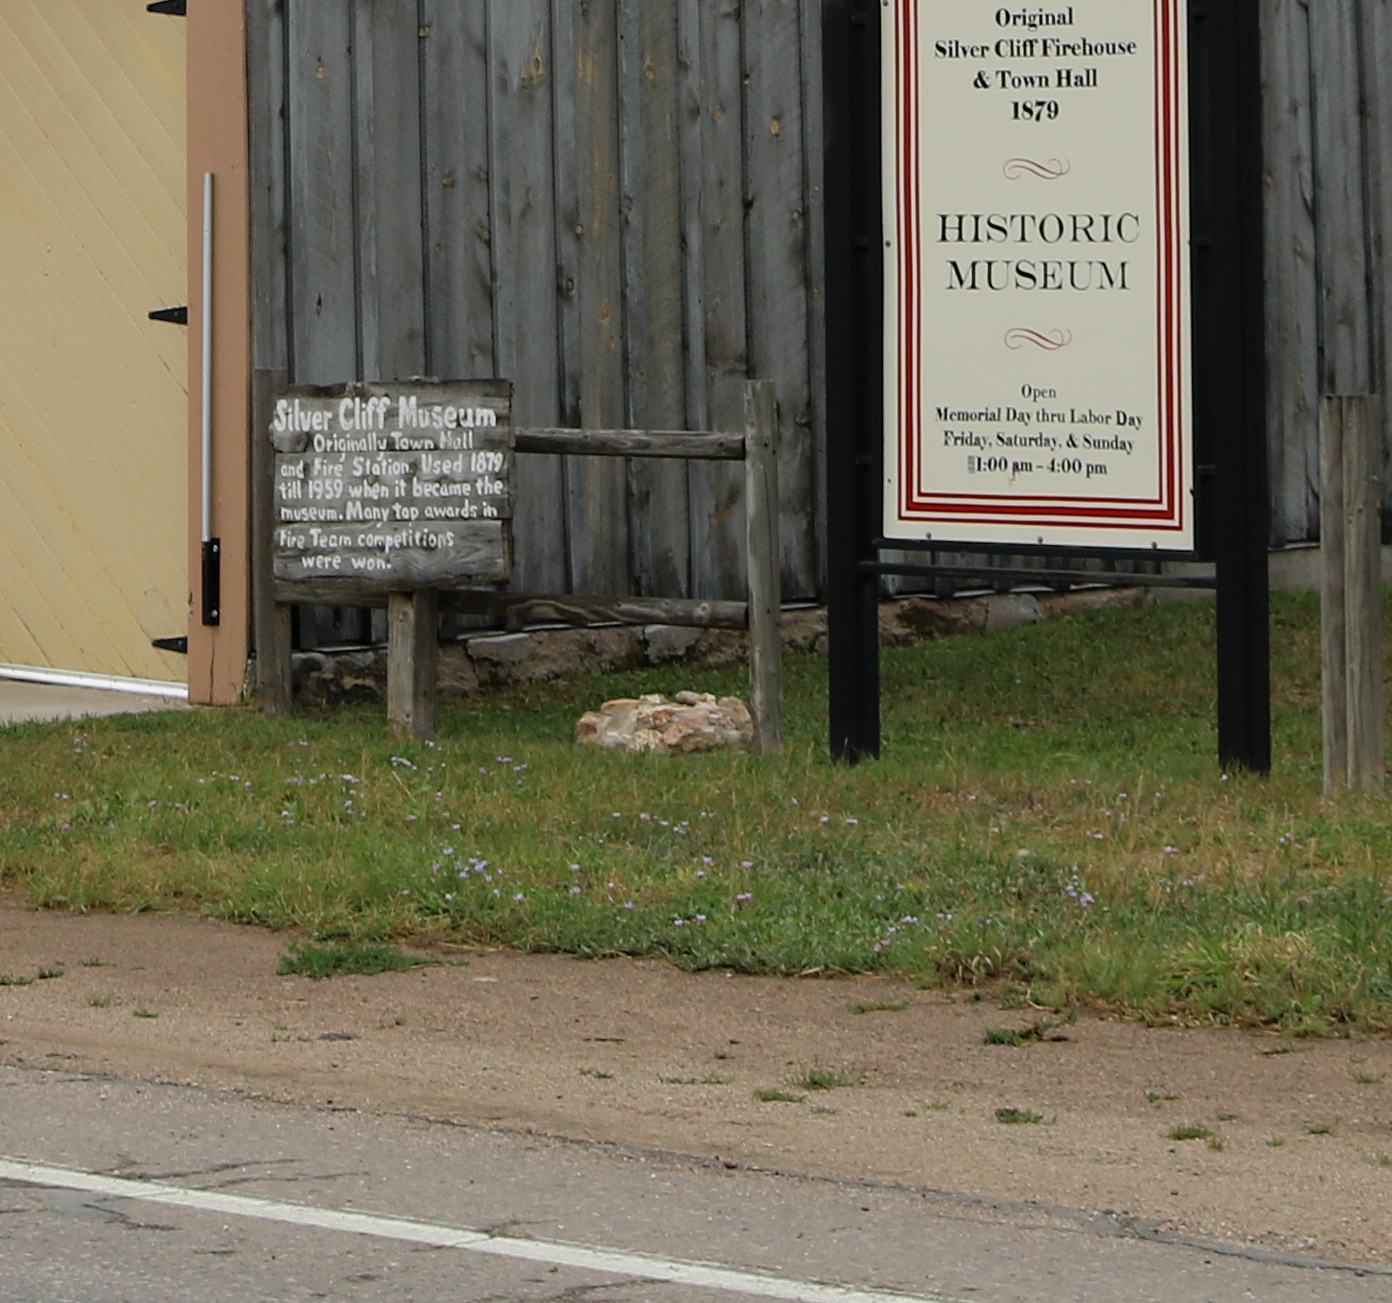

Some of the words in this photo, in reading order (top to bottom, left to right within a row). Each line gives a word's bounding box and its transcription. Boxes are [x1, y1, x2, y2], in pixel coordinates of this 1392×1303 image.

[995, 6, 1075, 32] Original
[934, 39, 990, 59] Silver
[994, 38, 1039, 58] Cliff
[1041, 37, 1138, 57] Firehouse
[973, 70, 990, 89] &
[995, 69, 1050, 89] Town
[1055, 68, 1098, 88] Hall
[1011, 100, 1060, 122] 1879
[935, 212, 1141, 244] HISTORIC
[945, 259, 1131, 291] MUSEUM
[1020, 384, 1057, 402] Open
[273, 398, 332, 432] Silver
[338, 396, 391, 431] Cliff
[398, 395, 497, 429] Museum
[935, 406, 1002, 422] Memorial
[1006, 407, 1033, 426] Day
[1036, 408, 1065, 423] thru
[1070, 409, 1112, 425] Labor
[1115, 410, 1143, 430] Day
[313, 432, 387, 462] Originally
[391, 431, 435, 451] Town
[439, 431, 474, 450] Hall
[943, 430, 993, 451] Friday,
[996, 431, 1063, 452] Saturday,
[1066, 433, 1078, 449] &
[1082, 433, 1134, 455] Sunday
[281, 460, 304, 478] and
[313, 457, 343, 478] Fire
[421, 453, 463, 474] Used
[470, 452, 505, 473] 1879
[1047, 457, 1082, 473] 4:00
[1085, 461, 1108, 478] pm
[278, 479, 302, 500] till
[308, 479, 344, 500] 1959
[349, 477, 390, 499] when
[394, 478, 407, 498] it
[412, 475, 471, 497] became
[475, 475, 505, 496] the
[281, 506, 344, 521] museum.
[346, 501, 391, 528] Many
[392, 502, 420, 526] top
[424, 499, 479, 519] awards
[483, 501, 498, 517] in
[279, 529, 306, 549] Fire
[310, 528, 353, 548] Team
[357, 528, 456, 554] competitions
[301, 554, 343, 569] were
[351, 555, 393, 570] won.
